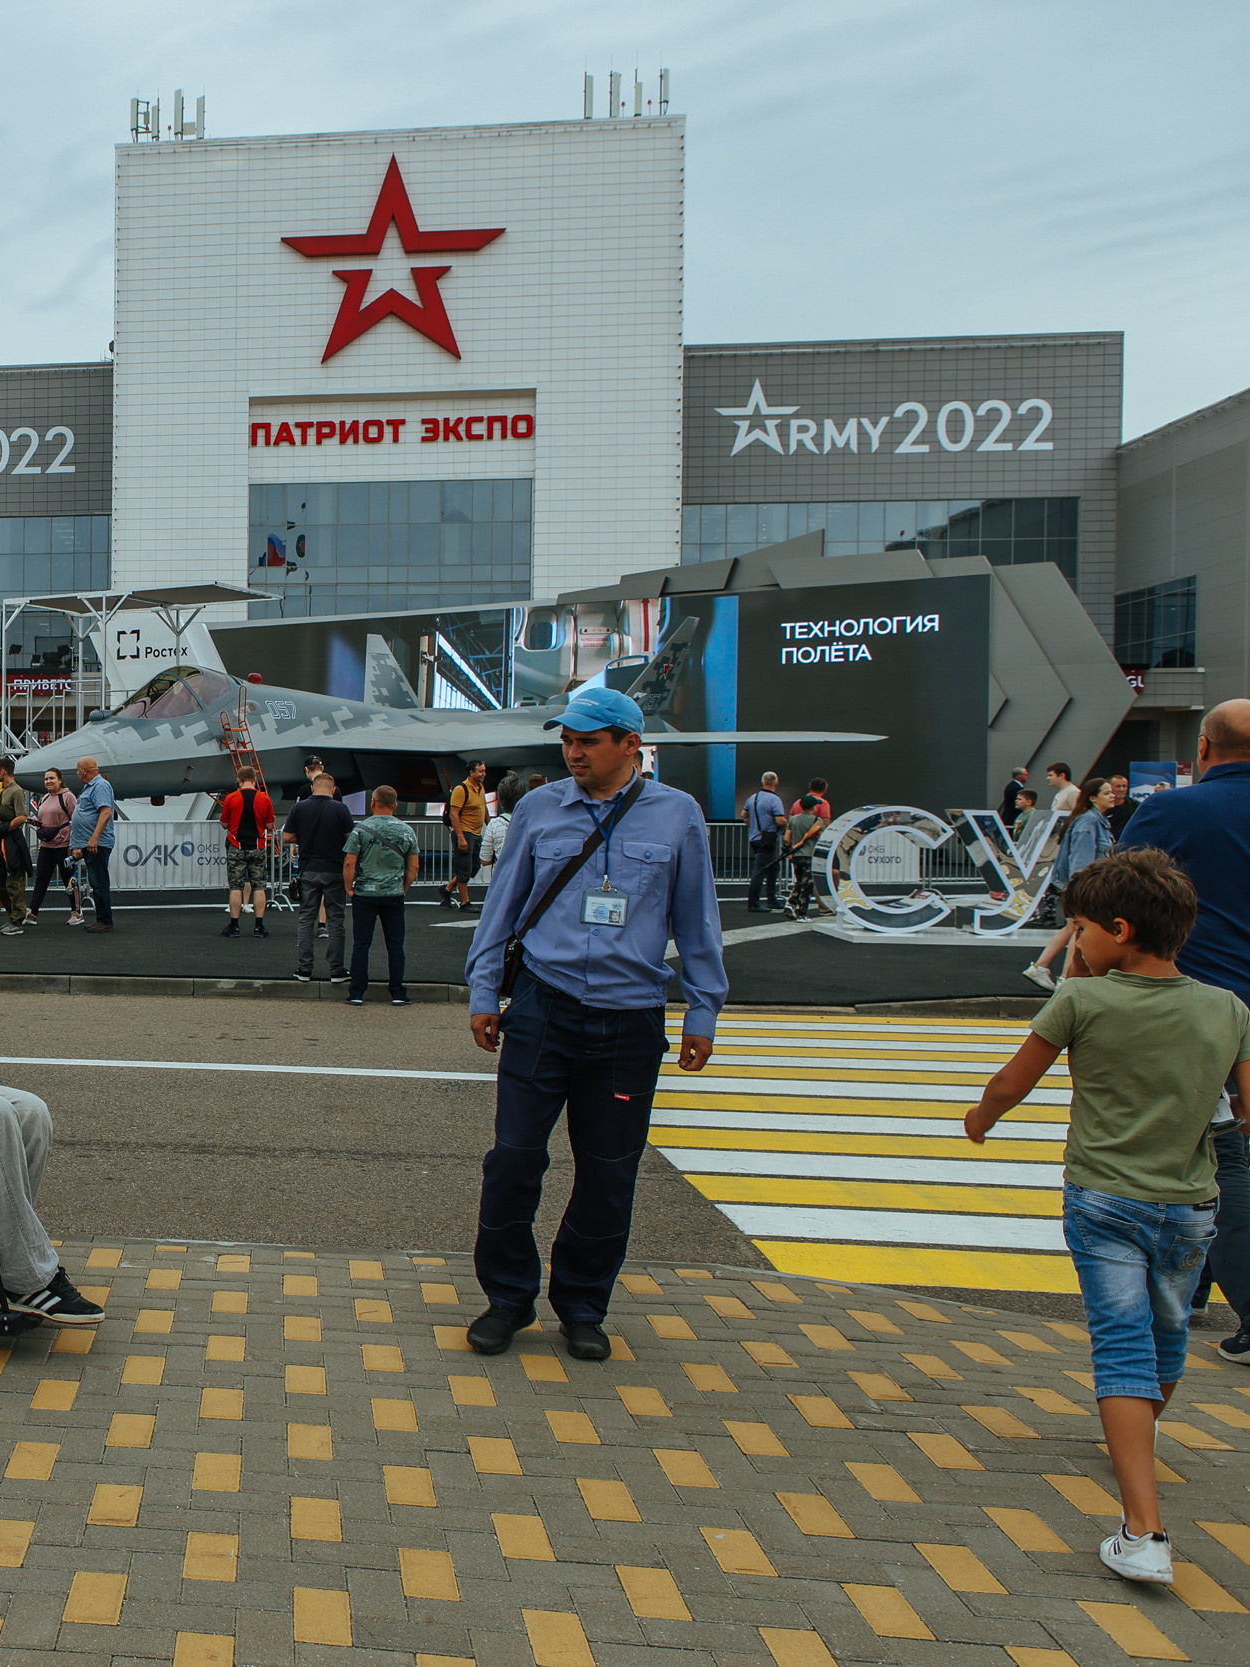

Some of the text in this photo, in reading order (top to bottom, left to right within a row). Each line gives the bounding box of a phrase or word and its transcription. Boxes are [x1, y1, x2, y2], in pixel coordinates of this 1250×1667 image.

[250, 414, 534, 446] ПАТРИОТ ЭКСПО
[893, 398, 1054, 454] 2022
[781, 614, 940, 639] ТЕХНОЛОГИЯ
[145, 646, 188, 659] Ростех
[781, 642, 872, 665] ПОЛЁТА
[265, 701, 296, 719] 057
[123, 844, 180, 867] ОАК
[197, 843, 220, 854] ОКБ
[197, 856, 227, 866] СУХО
[868, 856, 902, 864] СУХОГО
